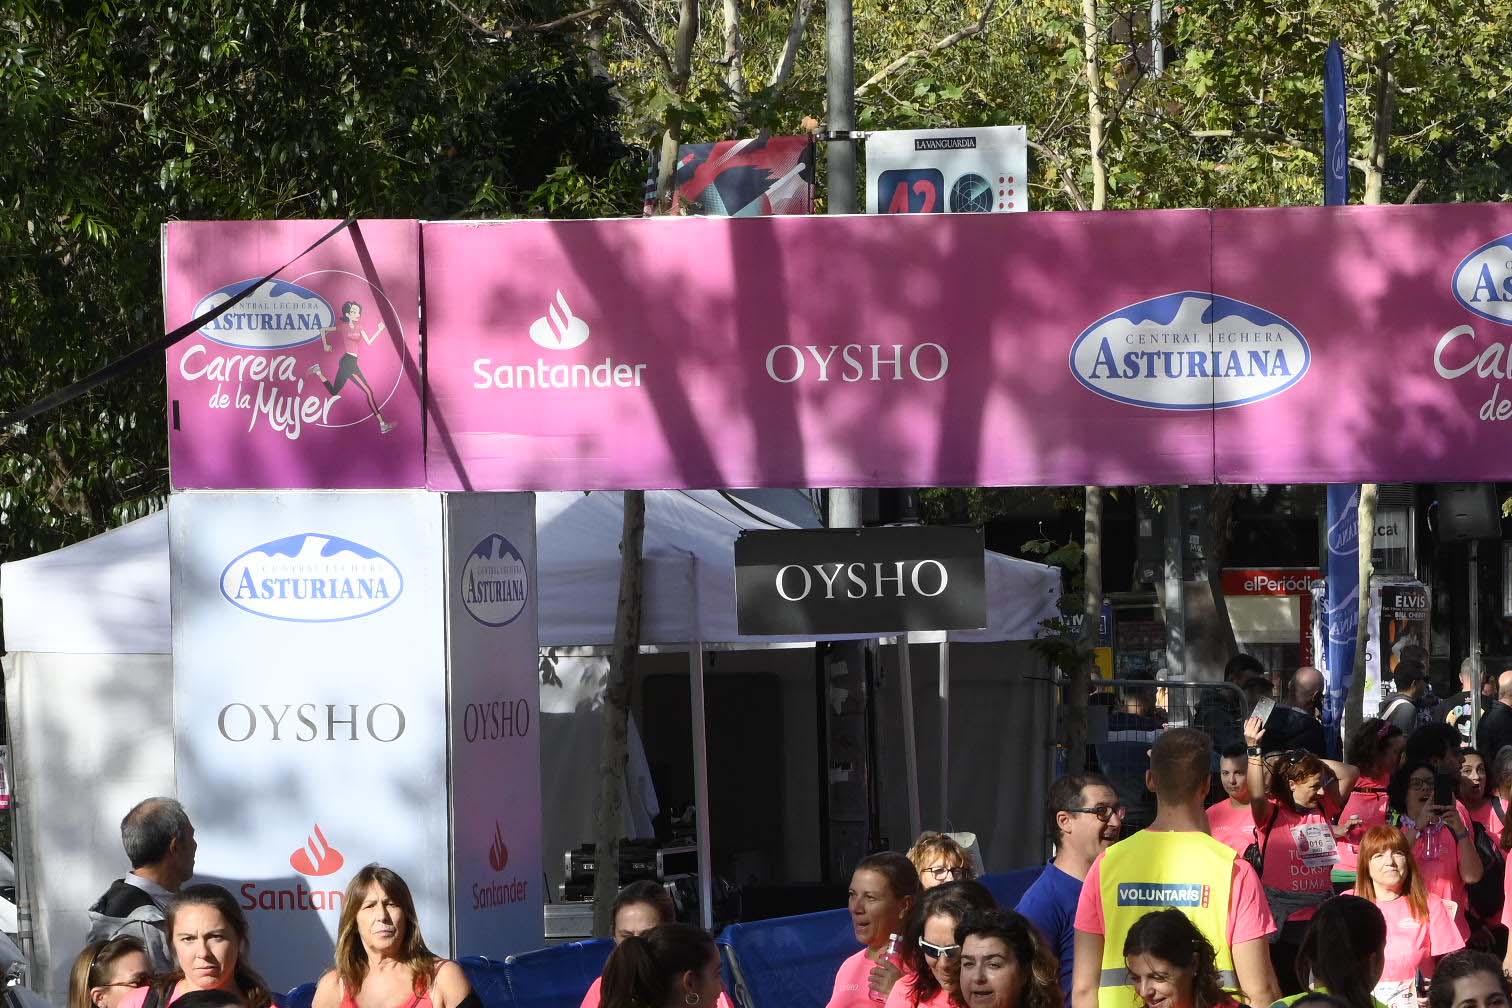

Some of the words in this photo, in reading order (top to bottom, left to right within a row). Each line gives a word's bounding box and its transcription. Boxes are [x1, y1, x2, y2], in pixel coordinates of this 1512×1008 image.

[203, 303, 322, 331] ASTURIANA
[1125, 332, 1201, 345] CENTRAL
[1208, 331, 1284, 344] LECHERA
[180, 344, 297, 382] Carrera
[472, 357, 647, 390] Santander
[765, 343, 949, 383] OYSHO
[1088, 337, 1292, 380] ASTURIANA
[208, 383, 231, 409] de
[235, 382, 251, 409] la
[248, 378, 341, 440] Mujer
[234, 567, 391, 600] ASTURIANA
[466, 569, 525, 604] ASTURIANA
[775, 559, 949, 602] OYSHO
[1244, 575, 1312, 592] elPeriódi
[1395, 595, 1426, 608] ELVIS
[217, 703, 406, 743] OYSHO
[464, 698, 530, 743] OYSHO
[240, 884, 345, 911] Santan
[472, 879, 528, 911] Santander
[1120, 888, 1200, 901] VOLUNTARIS
